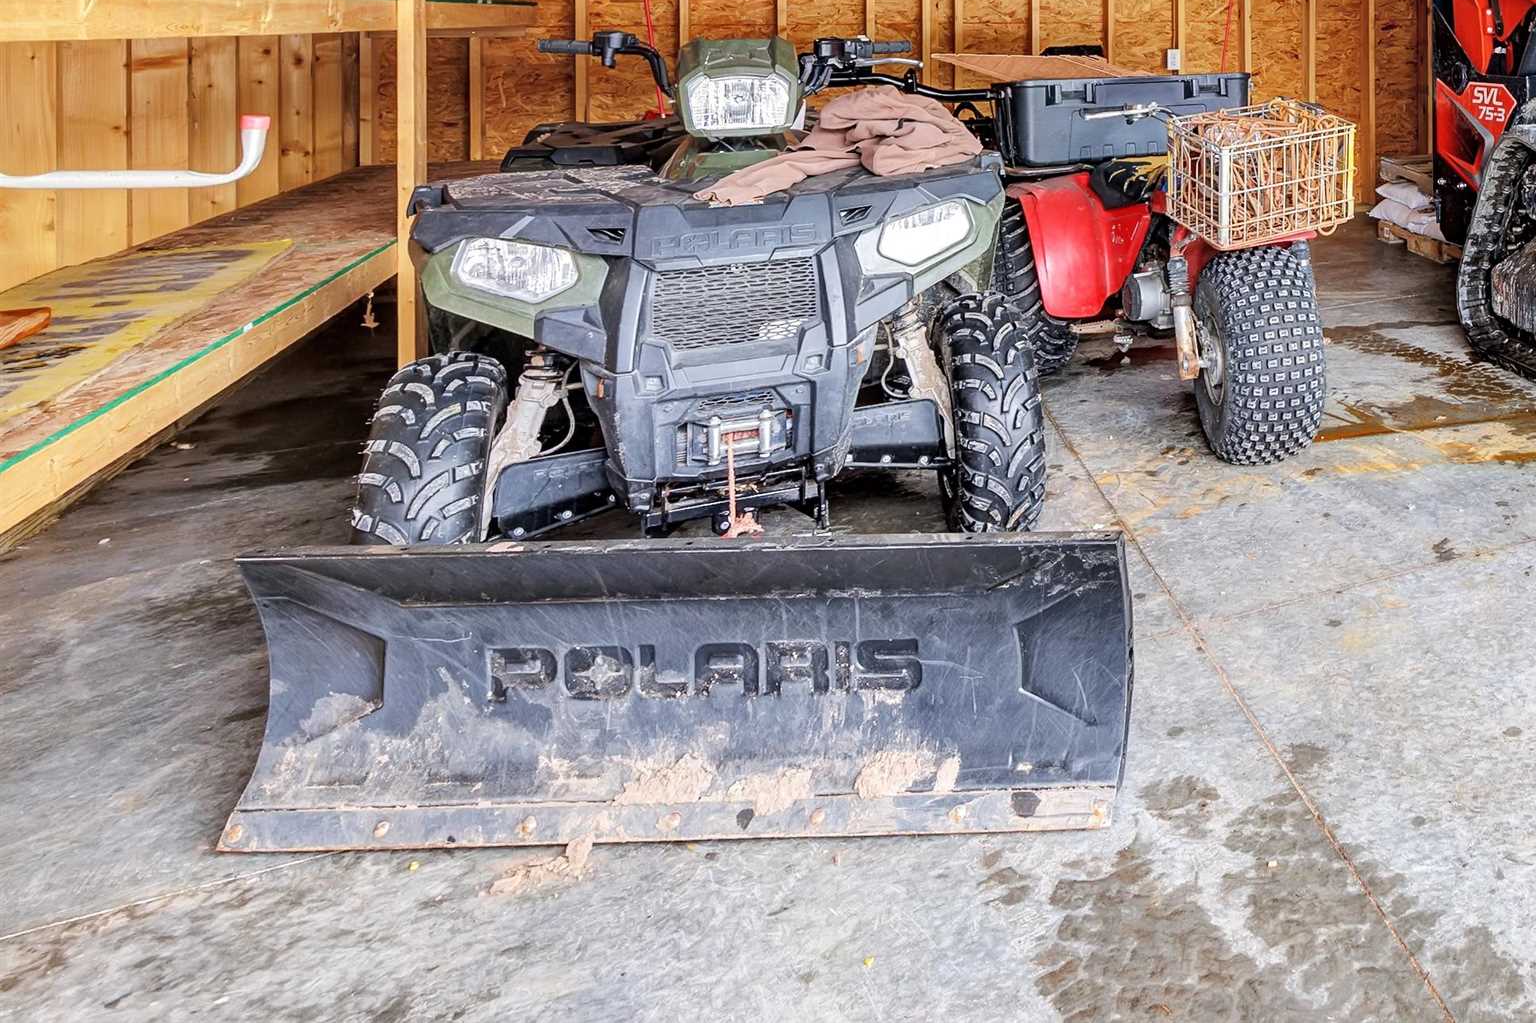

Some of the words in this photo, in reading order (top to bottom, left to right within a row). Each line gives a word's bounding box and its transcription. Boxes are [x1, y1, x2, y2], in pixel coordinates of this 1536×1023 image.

[1472, 86, 1503, 106] SVL
[1478, 105, 1505, 122] 75-3
[651, 223, 818, 257] POLARIS
[487, 637, 924, 704] POLARIS
